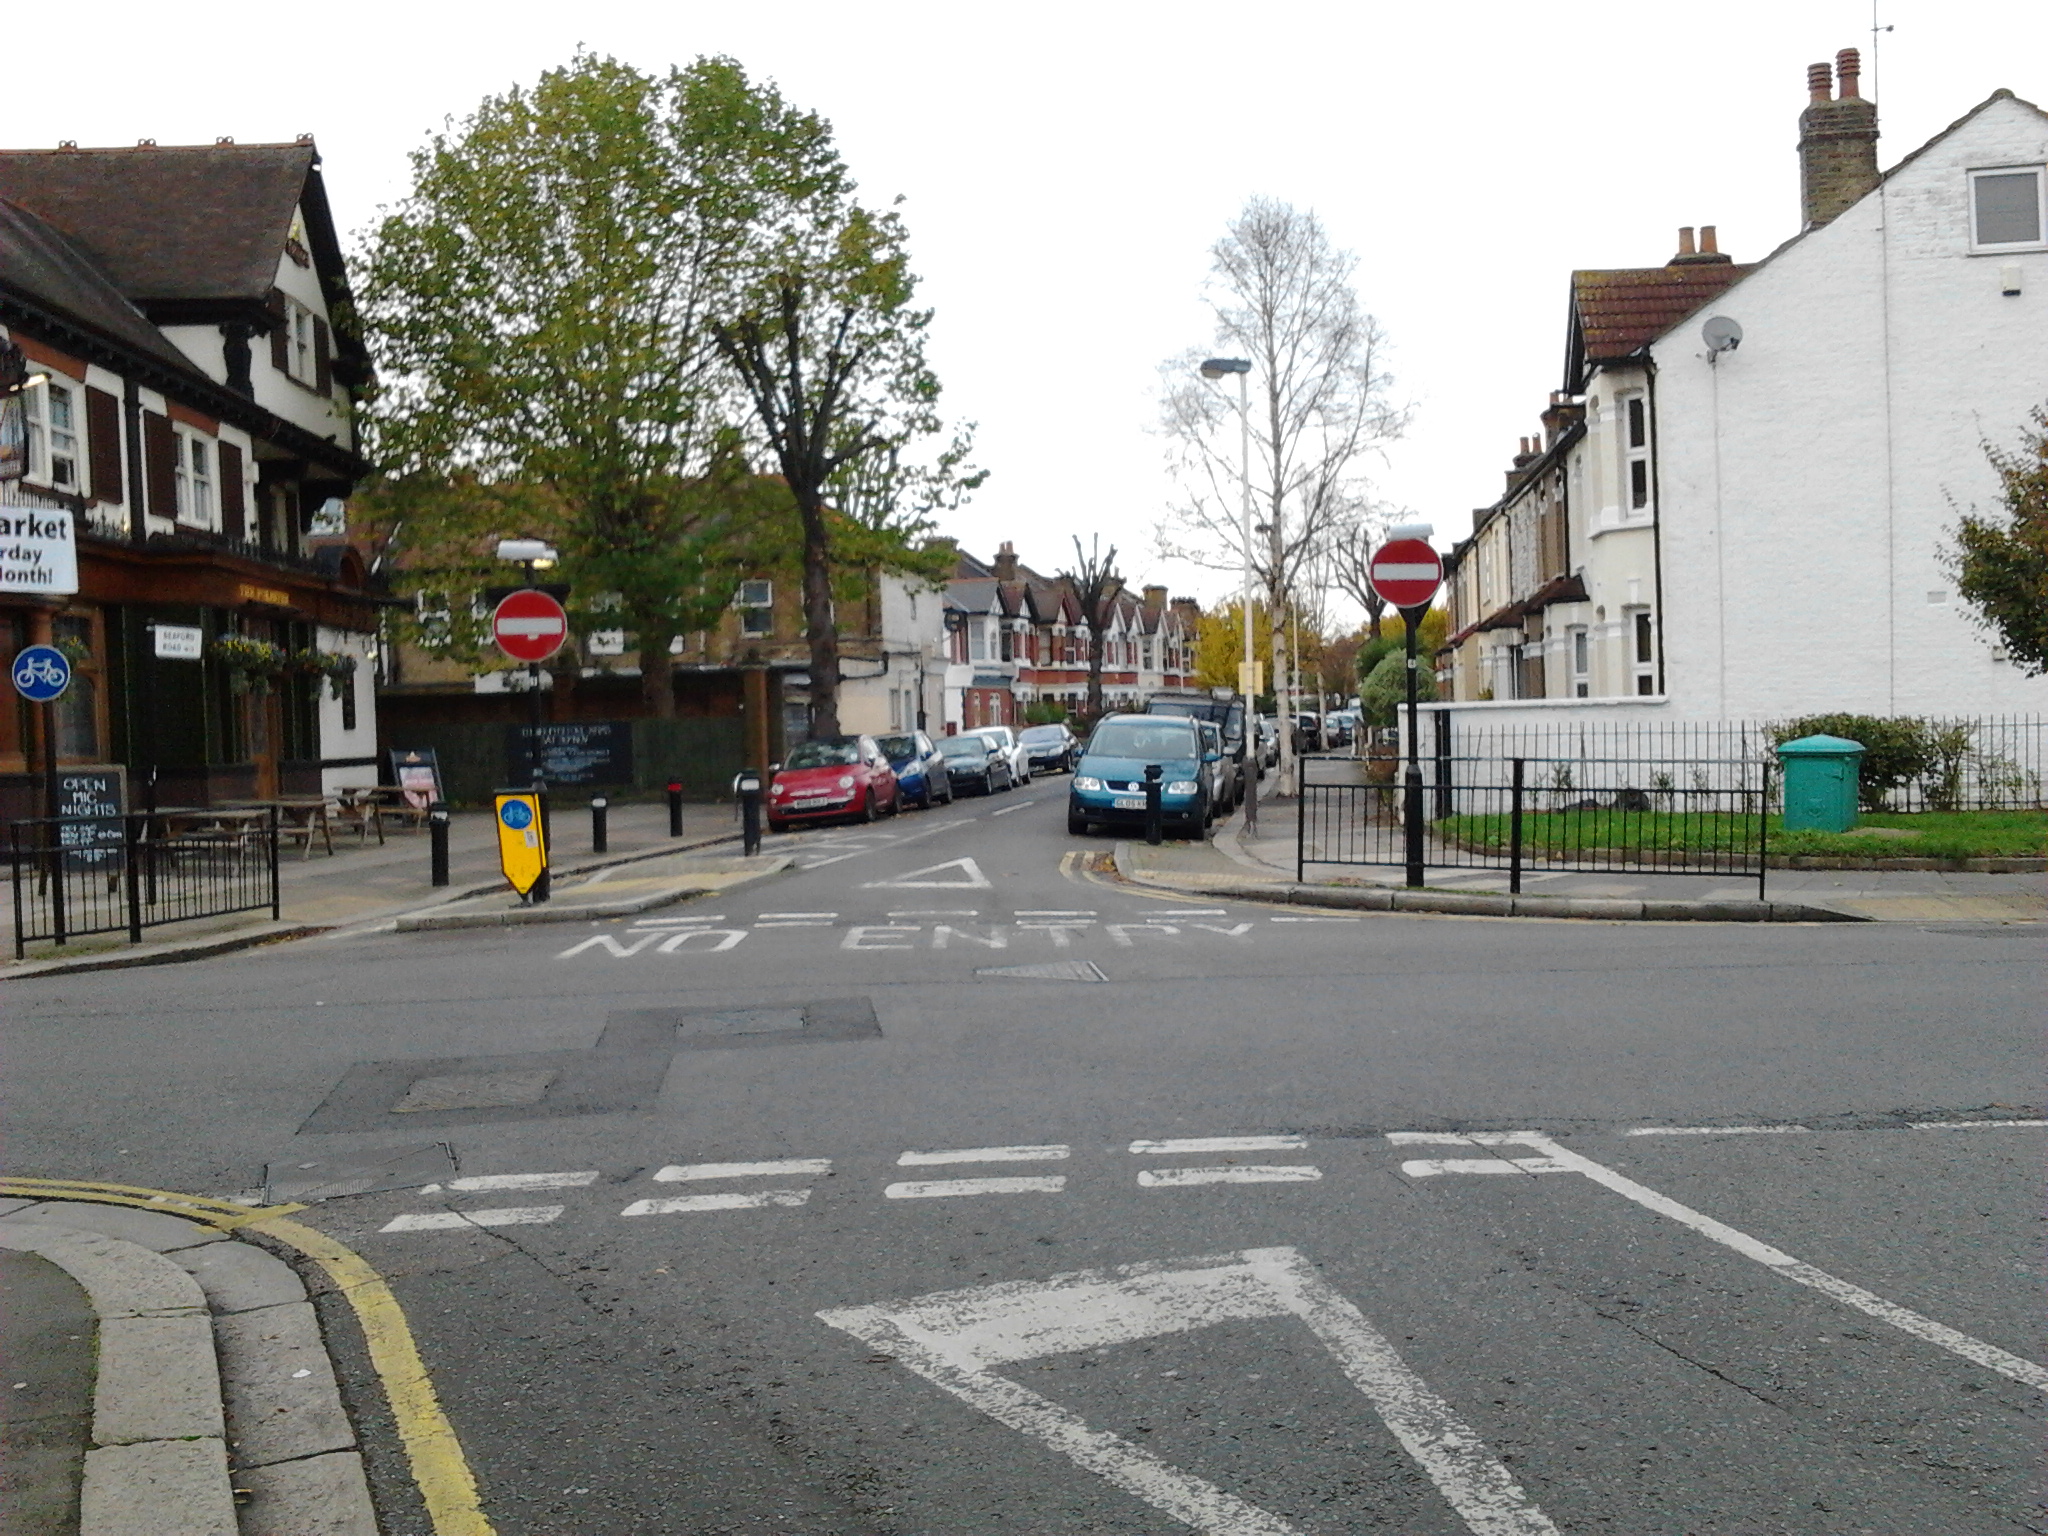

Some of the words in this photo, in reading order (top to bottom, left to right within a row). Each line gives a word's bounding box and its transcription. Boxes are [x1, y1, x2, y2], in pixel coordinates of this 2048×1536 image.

[0, 513, 67, 540] arket
[63, 778, 106, 792] OPEN
[73, 791, 97, 804] MIC
[61, 803, 116, 817] NIGHTS
[554, 929, 750, 960] NO
[840, 923, 1254, 949] ENTRY
